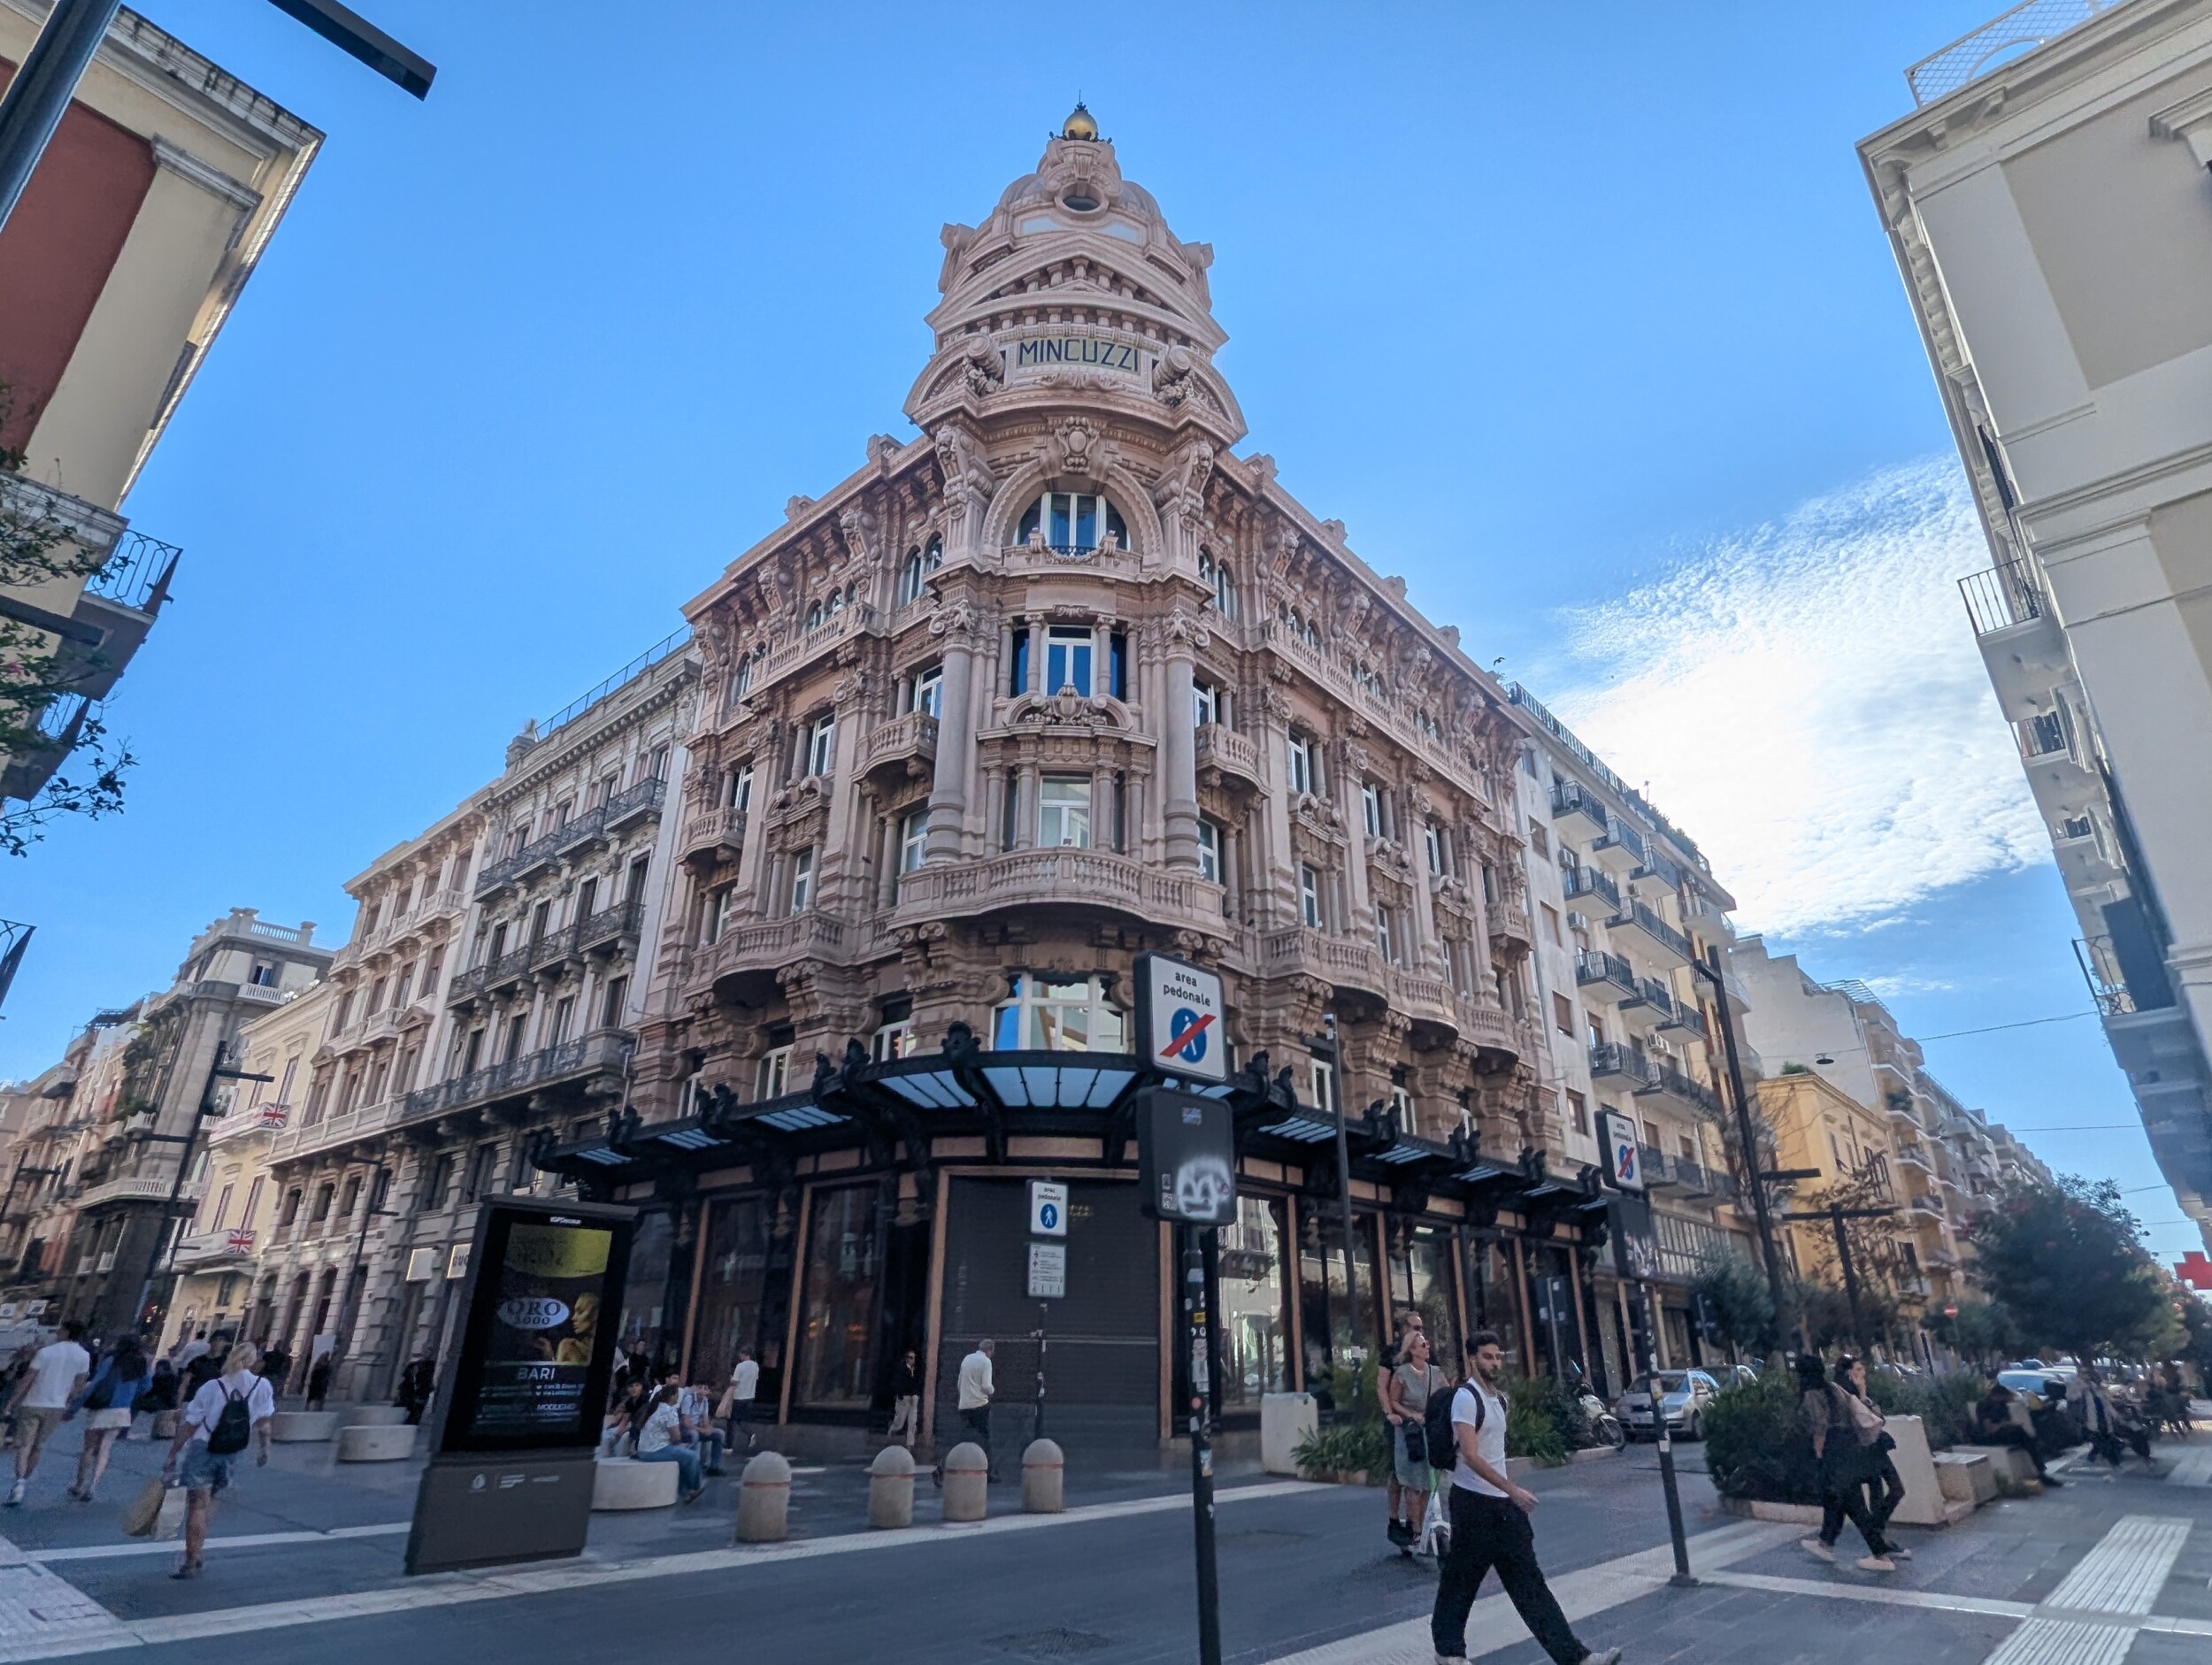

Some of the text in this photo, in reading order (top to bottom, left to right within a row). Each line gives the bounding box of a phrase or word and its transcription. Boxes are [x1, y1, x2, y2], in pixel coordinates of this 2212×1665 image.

[1018, 338, 1139, 372] MINCUZZI
[1175, 971, 1198, 987] area
[1163, 984, 1211, 1007] pedonale
[507, 1300, 562, 1316] ORO
[518, 1367, 556, 1380] BARI
